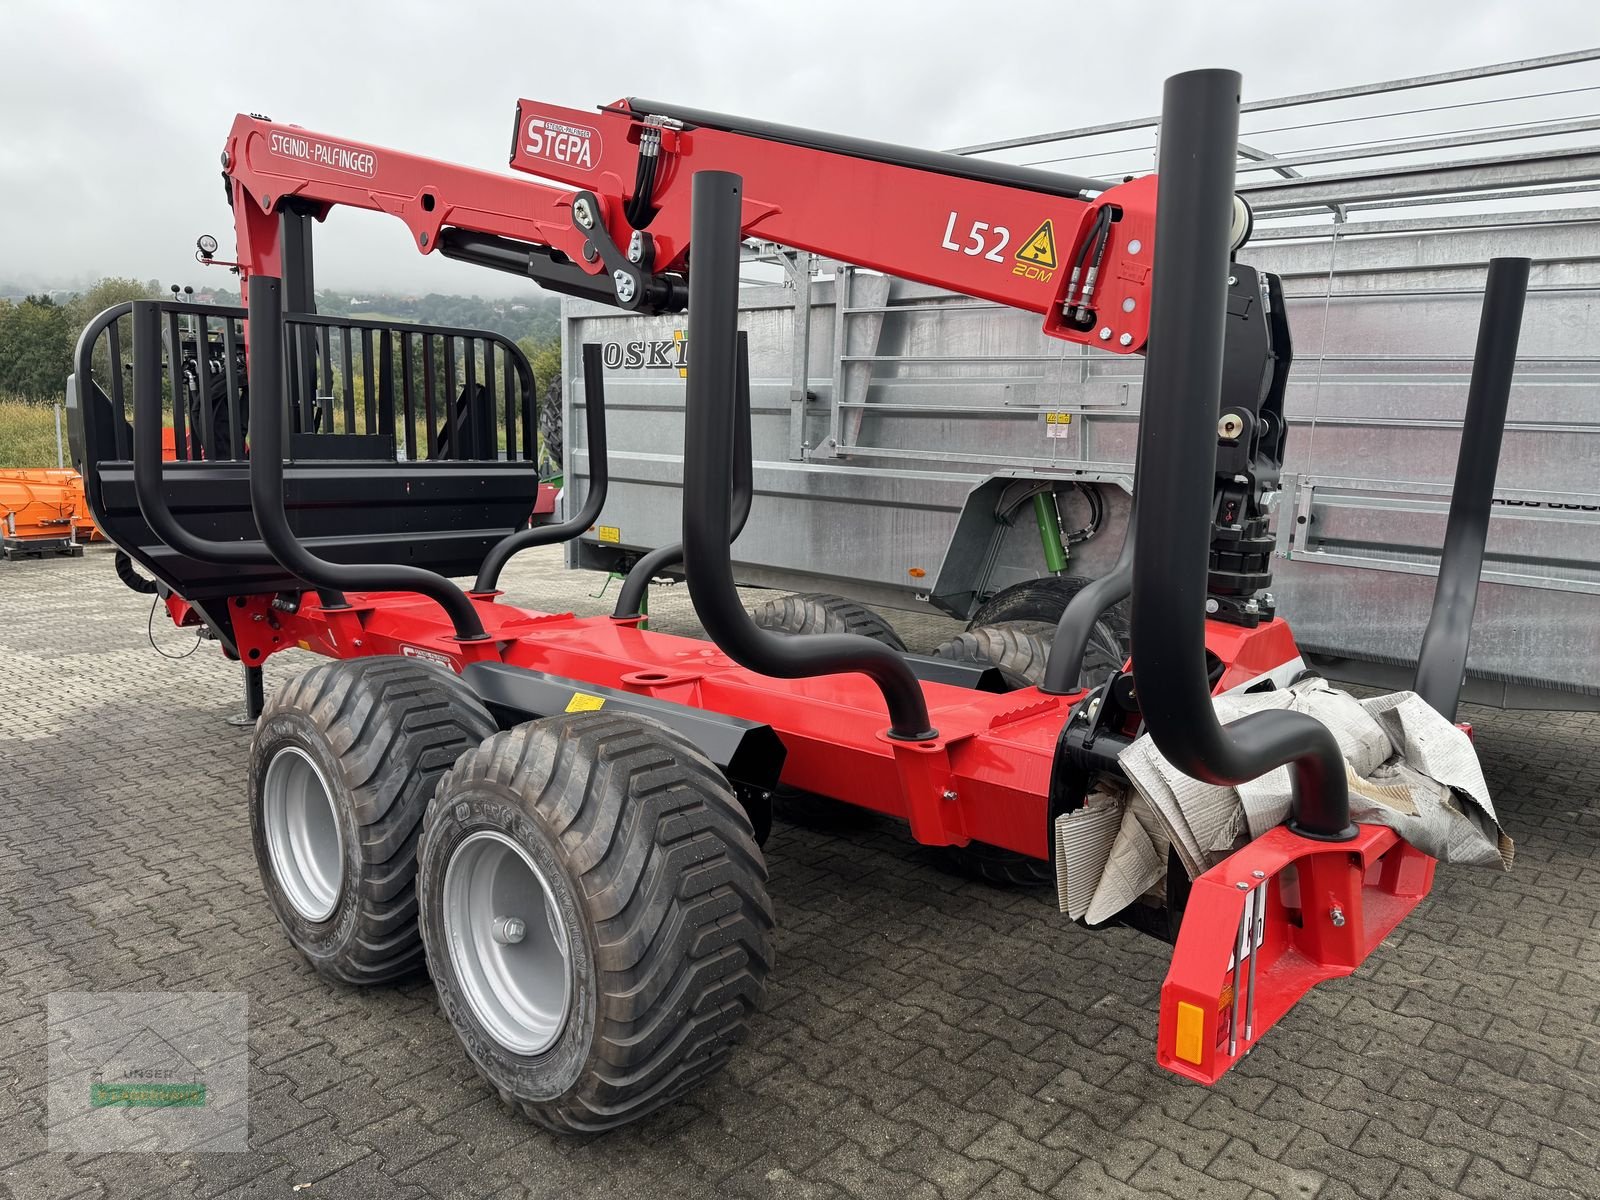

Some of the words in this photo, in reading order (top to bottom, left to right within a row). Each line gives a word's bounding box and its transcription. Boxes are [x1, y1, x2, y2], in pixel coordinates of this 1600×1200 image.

[271, 134, 373, 174] STEINDL-PALFINGER
[526, 119, 591, 167] STEPA
[941, 211, 1010, 263] L52
[1012, 263, 1052, 282] 20M
[583, 340, 689, 369] OSKI
